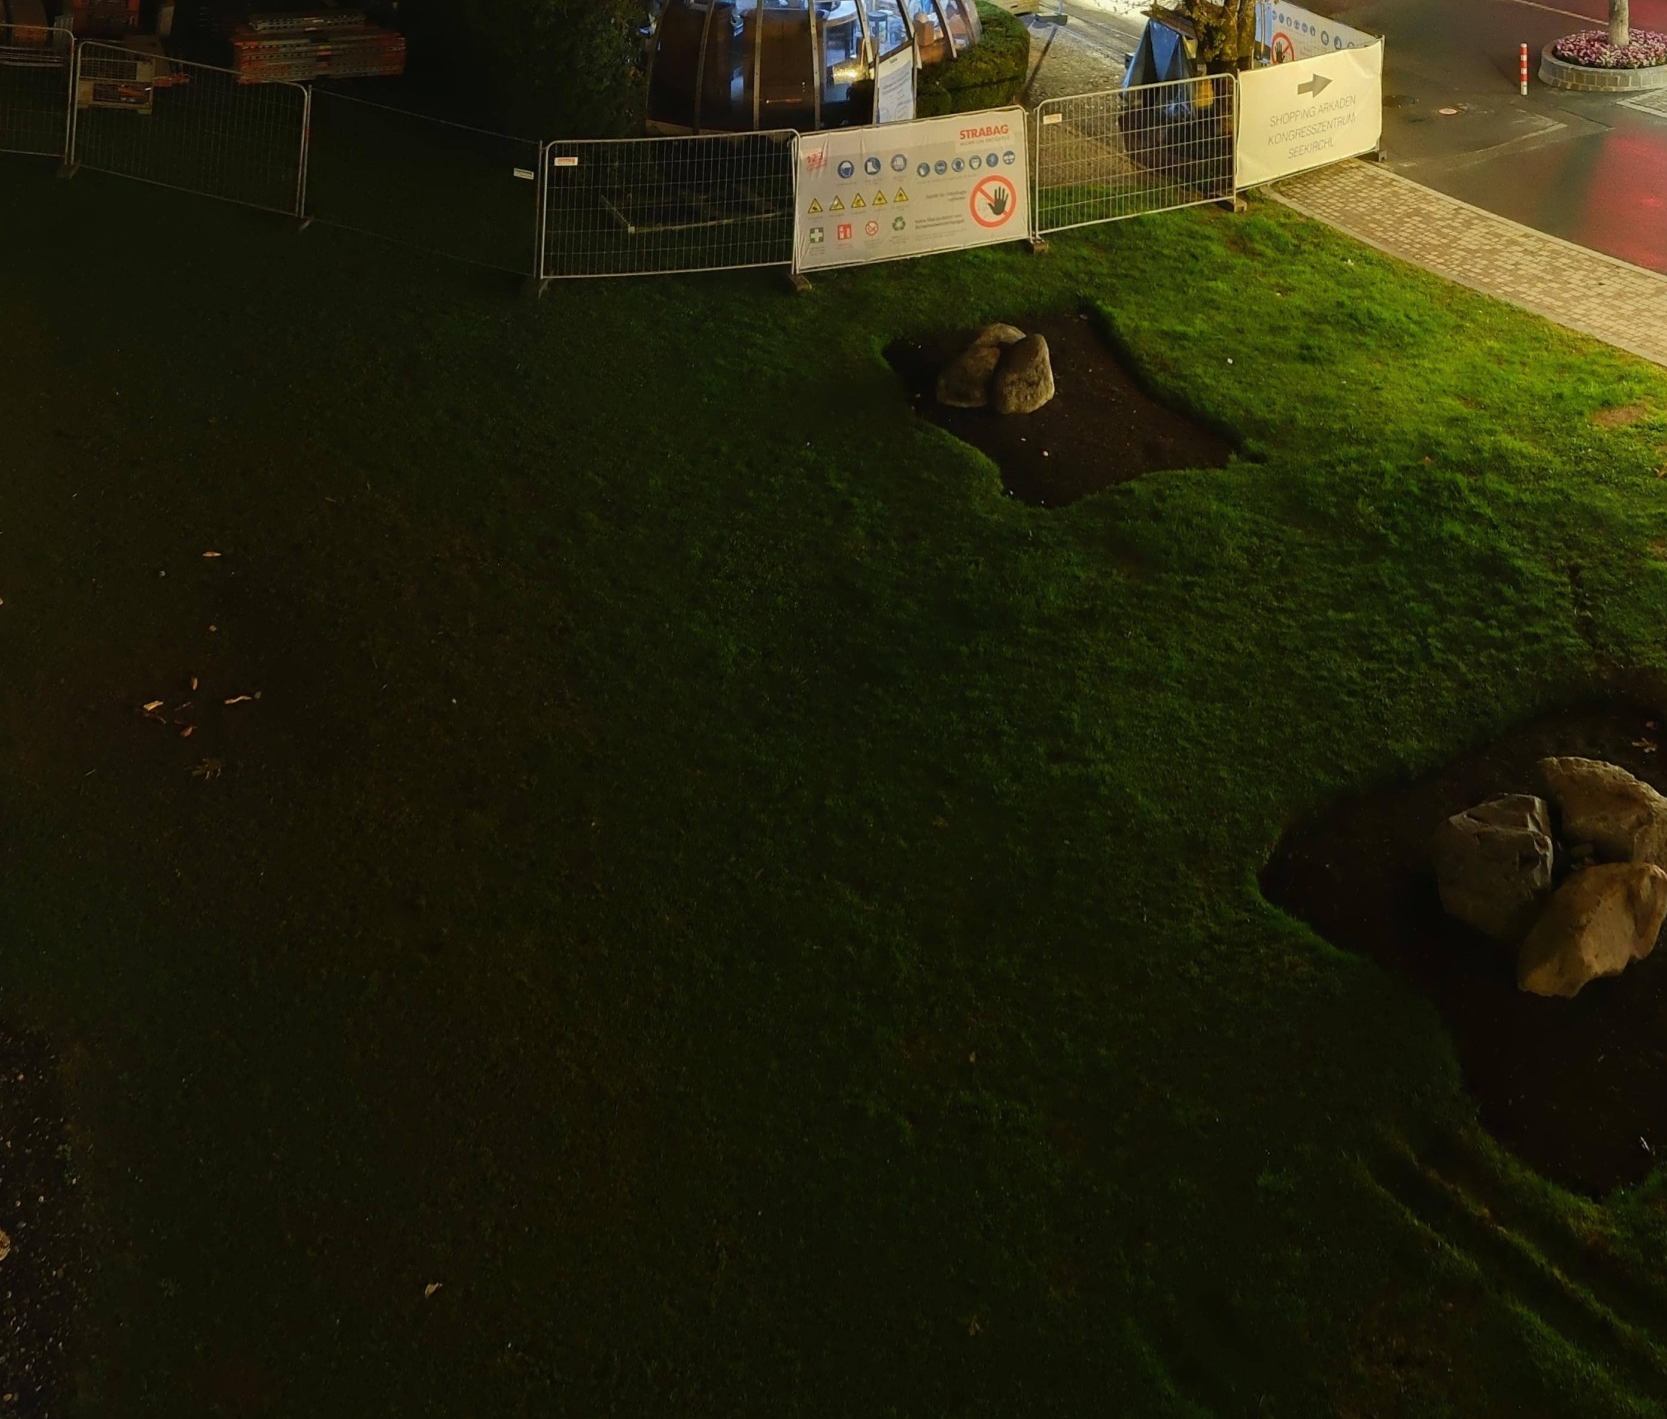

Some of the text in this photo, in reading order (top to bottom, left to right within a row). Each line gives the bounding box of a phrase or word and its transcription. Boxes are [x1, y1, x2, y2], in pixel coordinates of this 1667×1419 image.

[1269, 95, 1357, 128] SHOPPING ARKADEN
[959, 124, 1010, 140] STRABAG
[1267, 113, 1357, 145] KONGRESSZENTRUM
[1288, 138, 1335, 160] SEEKIRCHL
